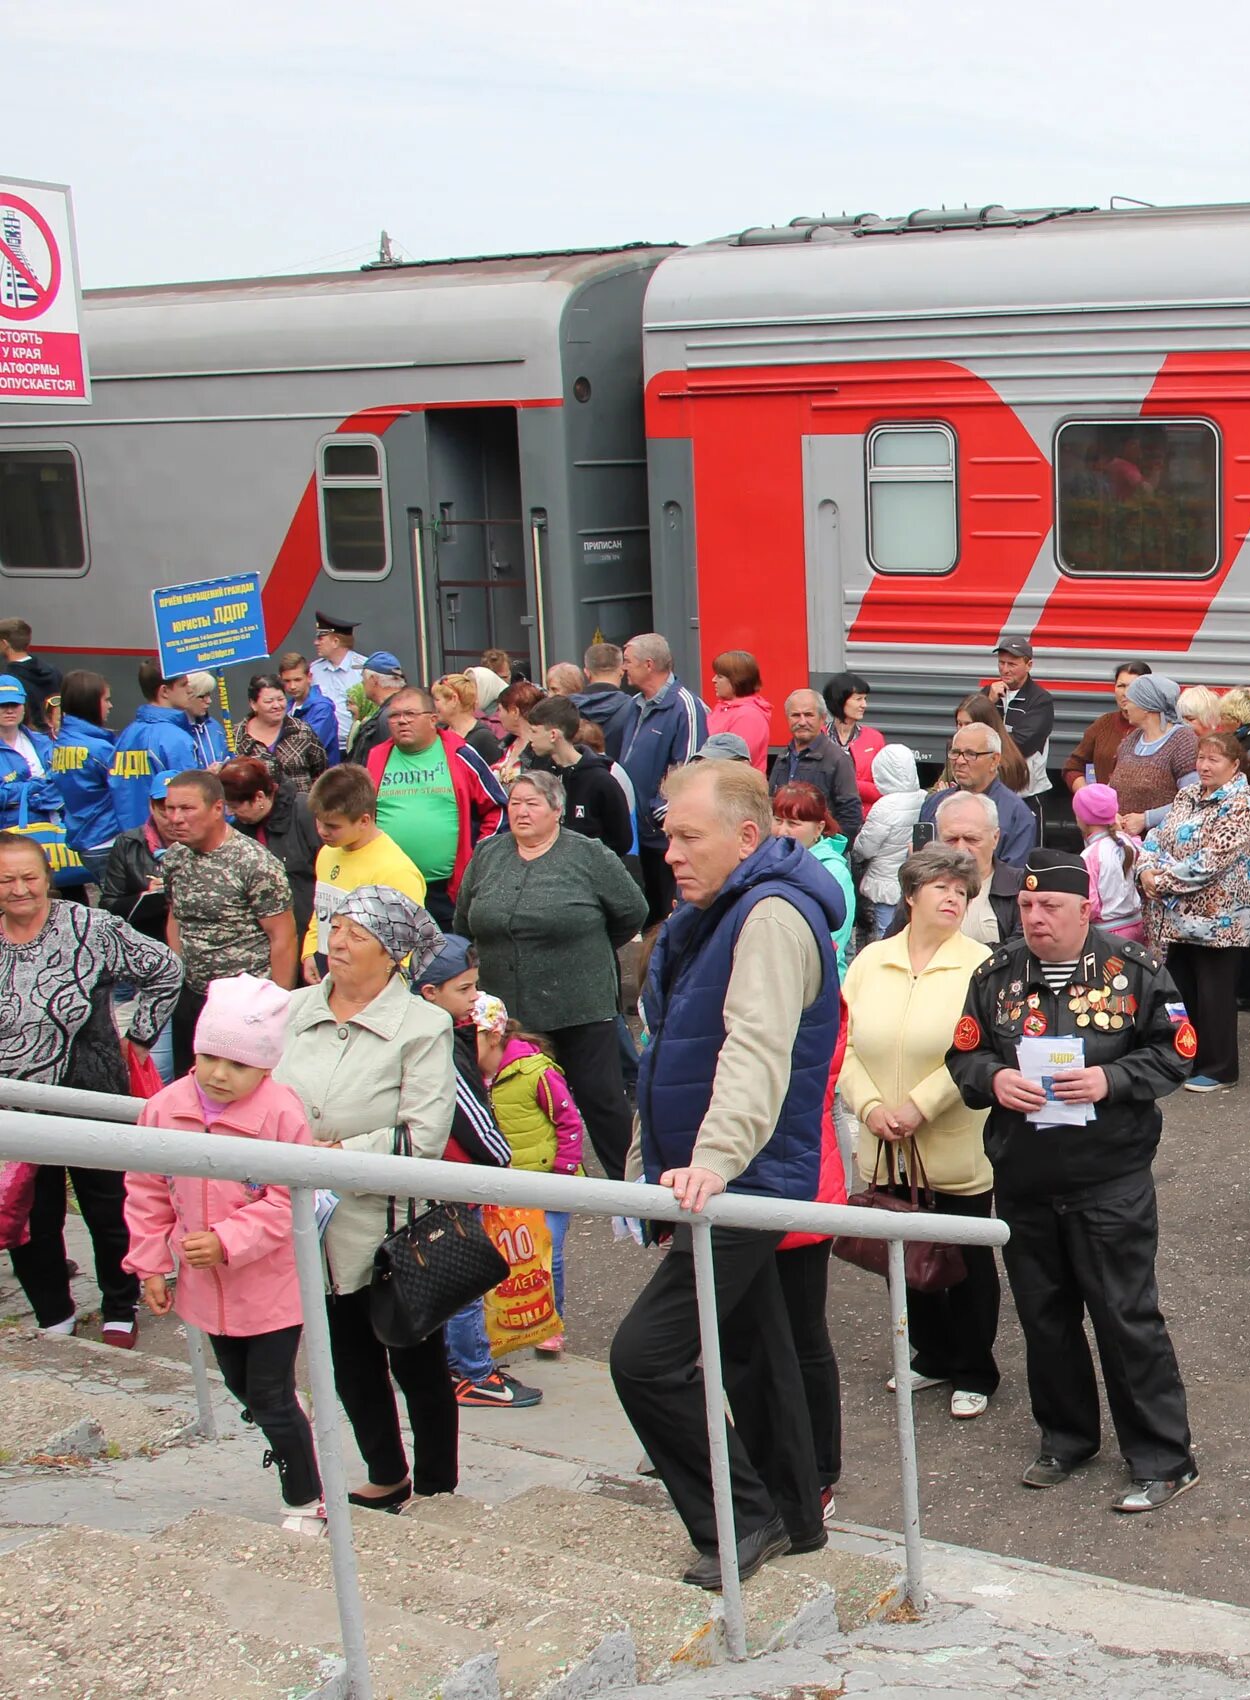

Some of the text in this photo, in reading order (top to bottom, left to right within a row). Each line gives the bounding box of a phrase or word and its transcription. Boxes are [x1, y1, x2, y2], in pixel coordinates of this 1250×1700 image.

[2, 346, 42, 360] У КРАЯ
[0, 362, 60, 376] АТФОРМЫ
[0, 377, 76, 391] ОПУСКАЕТСЯ!
[583, 540, 622, 551] ПРИПИСАН
[172, 602, 249, 633] ЮРИСТЫ ЛДПР
[382, 769, 434, 786] SOUTH
[1048, 1052, 1075, 1064] ЛДПР
[497, 1223, 534, 1266] 10
[514, 1272, 536, 1292] ЛЕТ
[509, 1301, 551, 1327] BILLA
